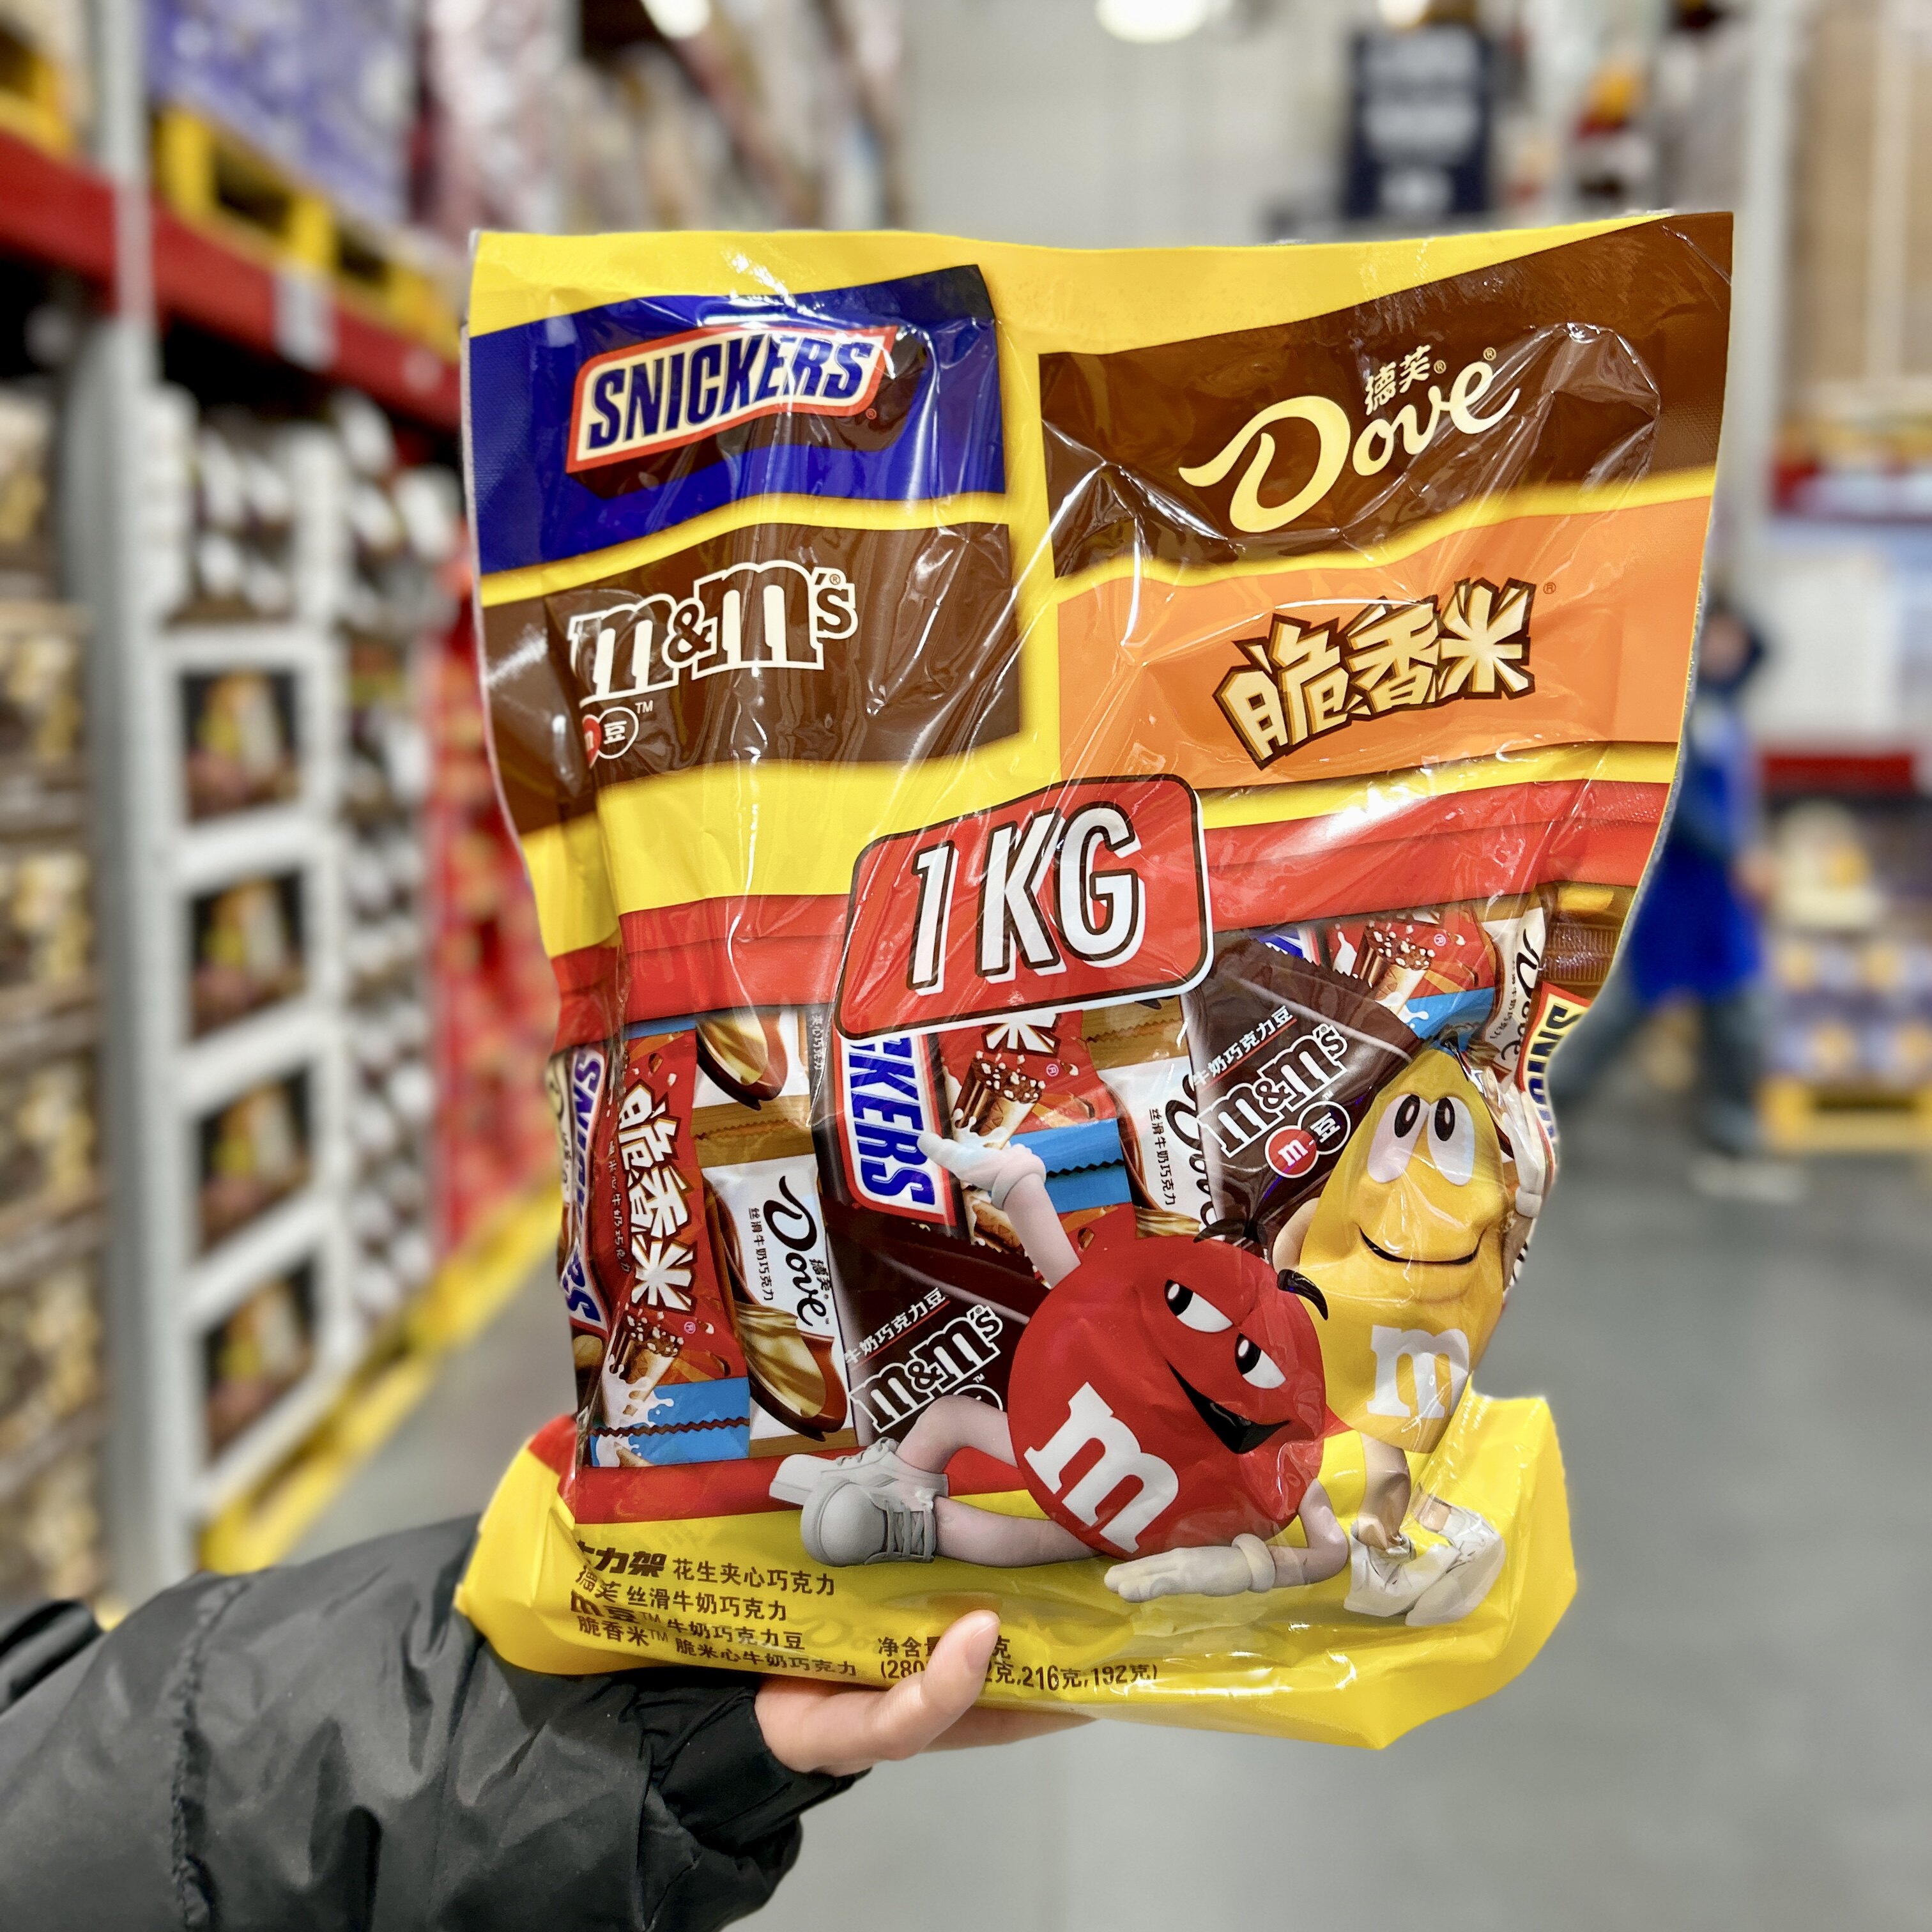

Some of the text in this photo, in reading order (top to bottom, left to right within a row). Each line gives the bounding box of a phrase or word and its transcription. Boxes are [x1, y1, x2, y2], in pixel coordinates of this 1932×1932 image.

[586, 333, 875, 450] SNICKERS
[1365, 344, 1432, 415] 德芙
[1179, 361, 1521, 533] Dove
[1214, 577, 1536, 770] 脆香米
[907, 801, 1146, 997] 1 KG
[1193, 1005, 1293, 1087] 牛奶巧克力豆
[617, 1079, 697, 1314] 脆香米
[1149, 1108, 1176, 1206] 丝滑牛奶巧克力
[748, 1207, 774, 1301] 丝滑牛奶巧克力
[763, 1176, 827, 1328] Dove
[844, 1286, 946, 1364] 牛奶巧克力豆
[1367, 1324, 1471, 1419] m
[1023, 1381, 1180, 1554] m
[626, 1585, 787, 1621] 丝滑牛奶巧克力
[673, 1558, 835, 1597] 花生夹心巧克力
[666, 1618, 806, 1650] 牛奶巧克力豆
[675, 1637, 857, 1677] 脆米心牛奶巧克力
